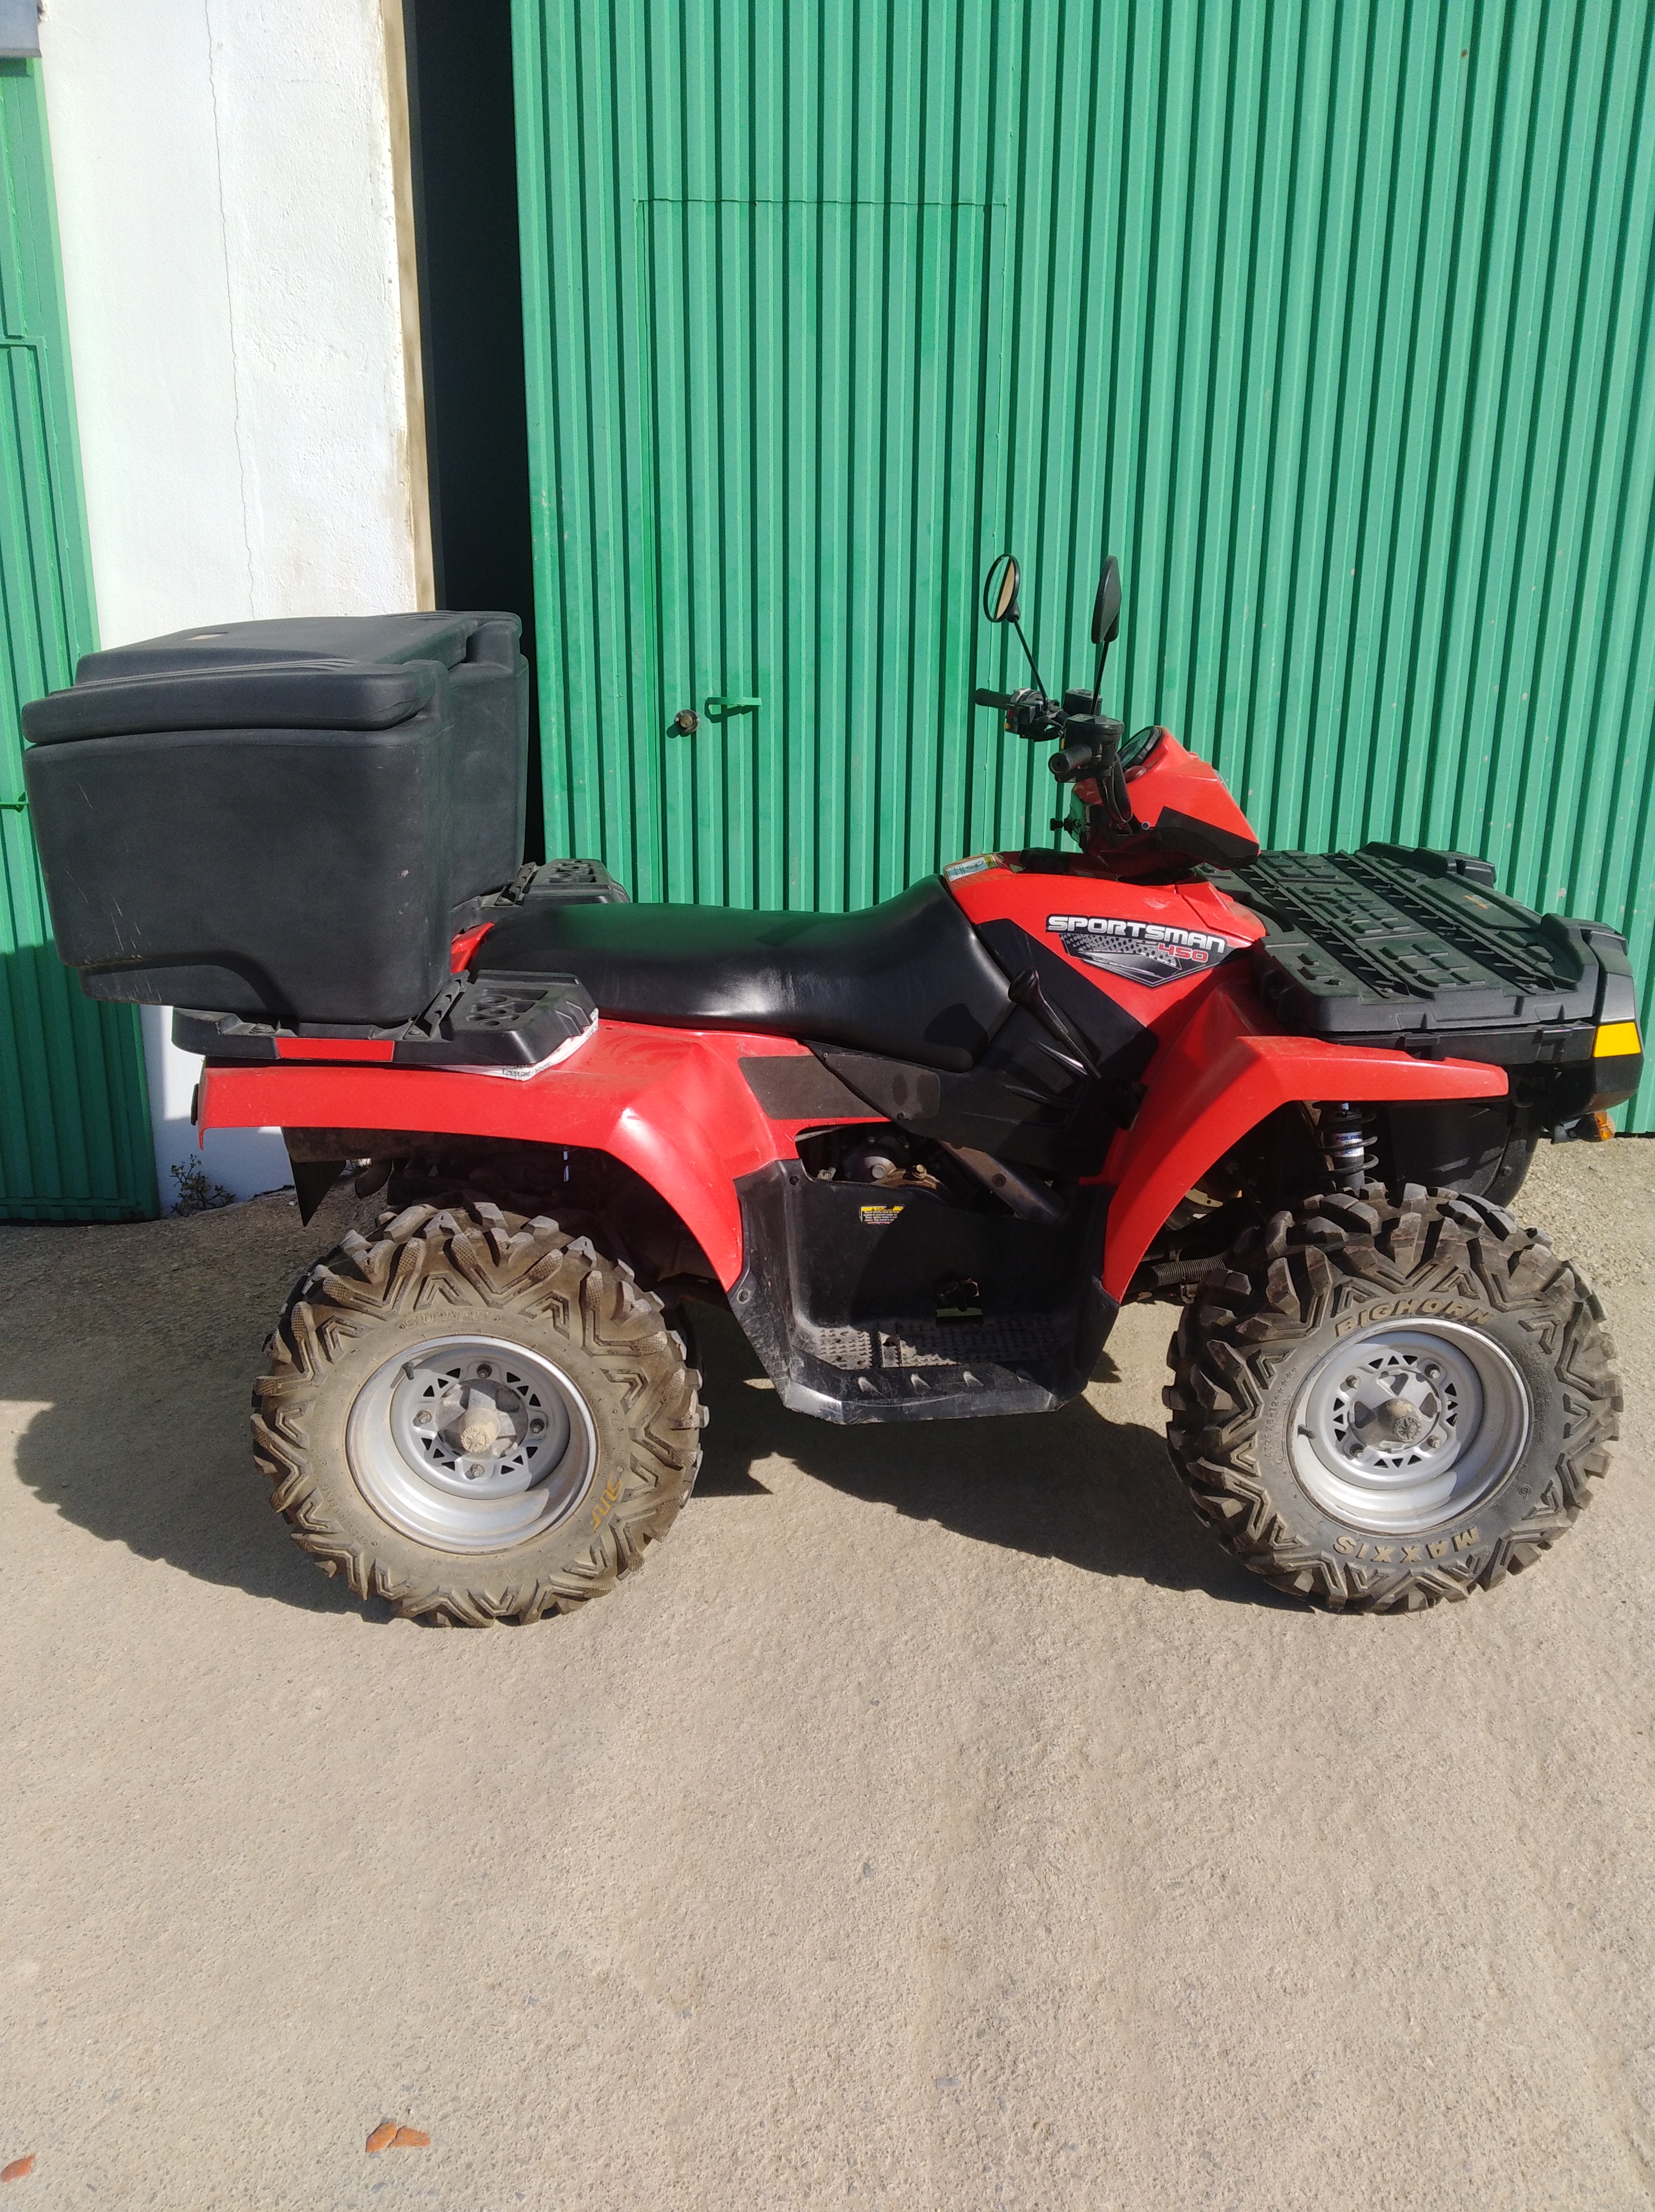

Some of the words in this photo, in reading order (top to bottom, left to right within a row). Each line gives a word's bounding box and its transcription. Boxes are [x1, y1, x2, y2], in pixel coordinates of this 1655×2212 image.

[1048, 916, 1226, 953] SPORTSMAN
[1158, 943, 1209, 963] 450
[1335, 1299, 1494, 1338] BIGHORN
[1333, 1525, 1480, 1563] MAXXIS
